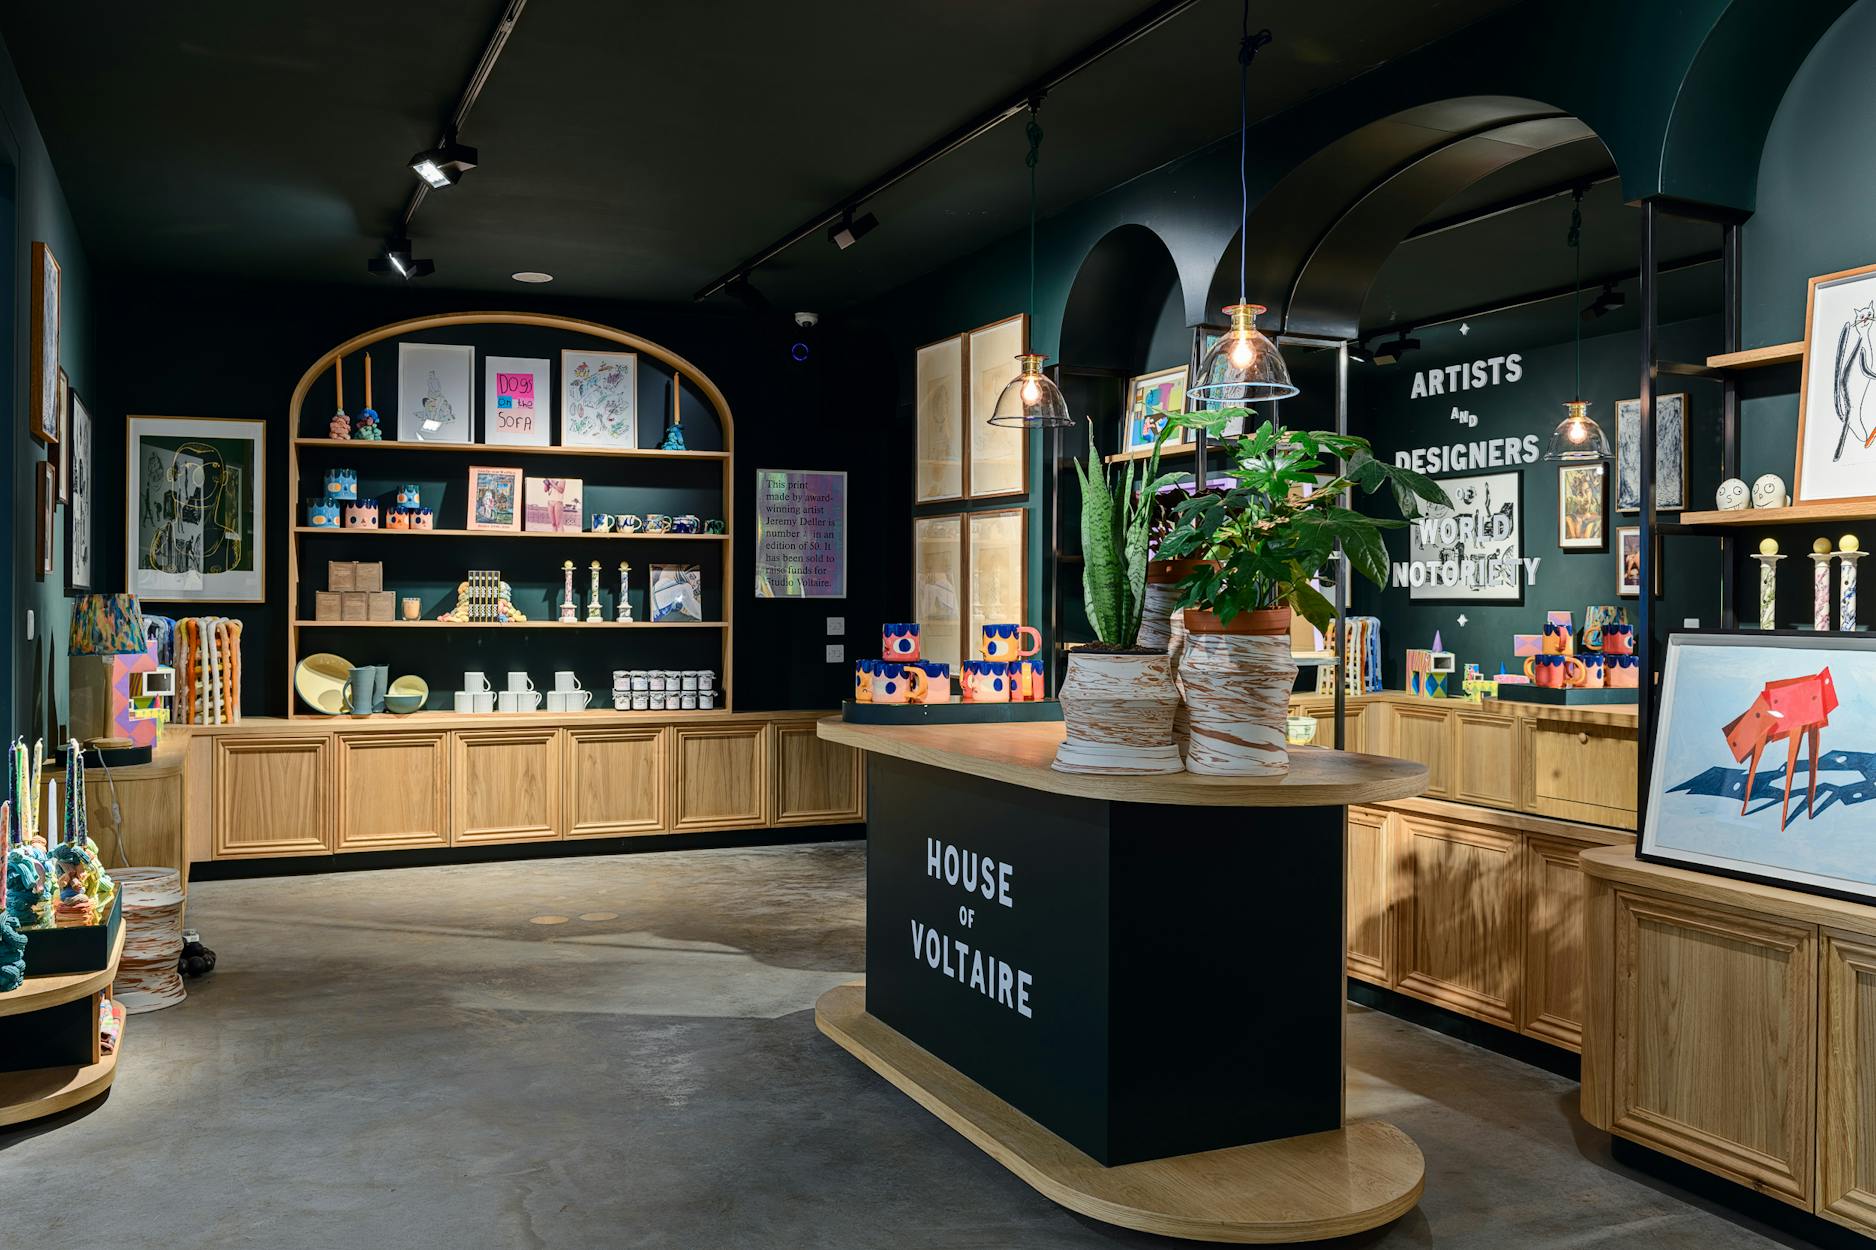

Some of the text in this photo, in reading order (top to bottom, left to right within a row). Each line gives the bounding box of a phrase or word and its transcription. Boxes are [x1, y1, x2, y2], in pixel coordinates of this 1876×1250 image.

[1411, 353, 1523, 399] ARTISTS
[517, 399, 534, 409] the
[1450, 406, 1478, 428] AND
[1395, 434, 1540, 475] DESIGNERS
[766, 480, 808, 491] This print
[766, 493, 790, 501] made
[792, 493, 803, 503] by
[766, 504, 824, 515] winning artist
[766, 517, 836, 528] Jeremy Deller is
[766, 530, 800, 538] number
[813, 531, 822, 539] in
[824, 531, 835, 539] an
[1419, 514, 1511, 545] WORLD
[766, 541, 796, 550] edition
[799, 541, 808, 550] of
[824, 542, 832, 550] It
[766, 554, 780, 562] has
[782, 554, 804, 562] been
[806, 554, 824, 562] sold
[766, 566, 827, 575] raise funds for
[1392, 557, 1542, 588] NOTORIETY
[927, 837, 1013, 908] HOUSE
[959, 905, 975, 928] OF
[911, 919, 1032, 1019] VOLTAIRE
